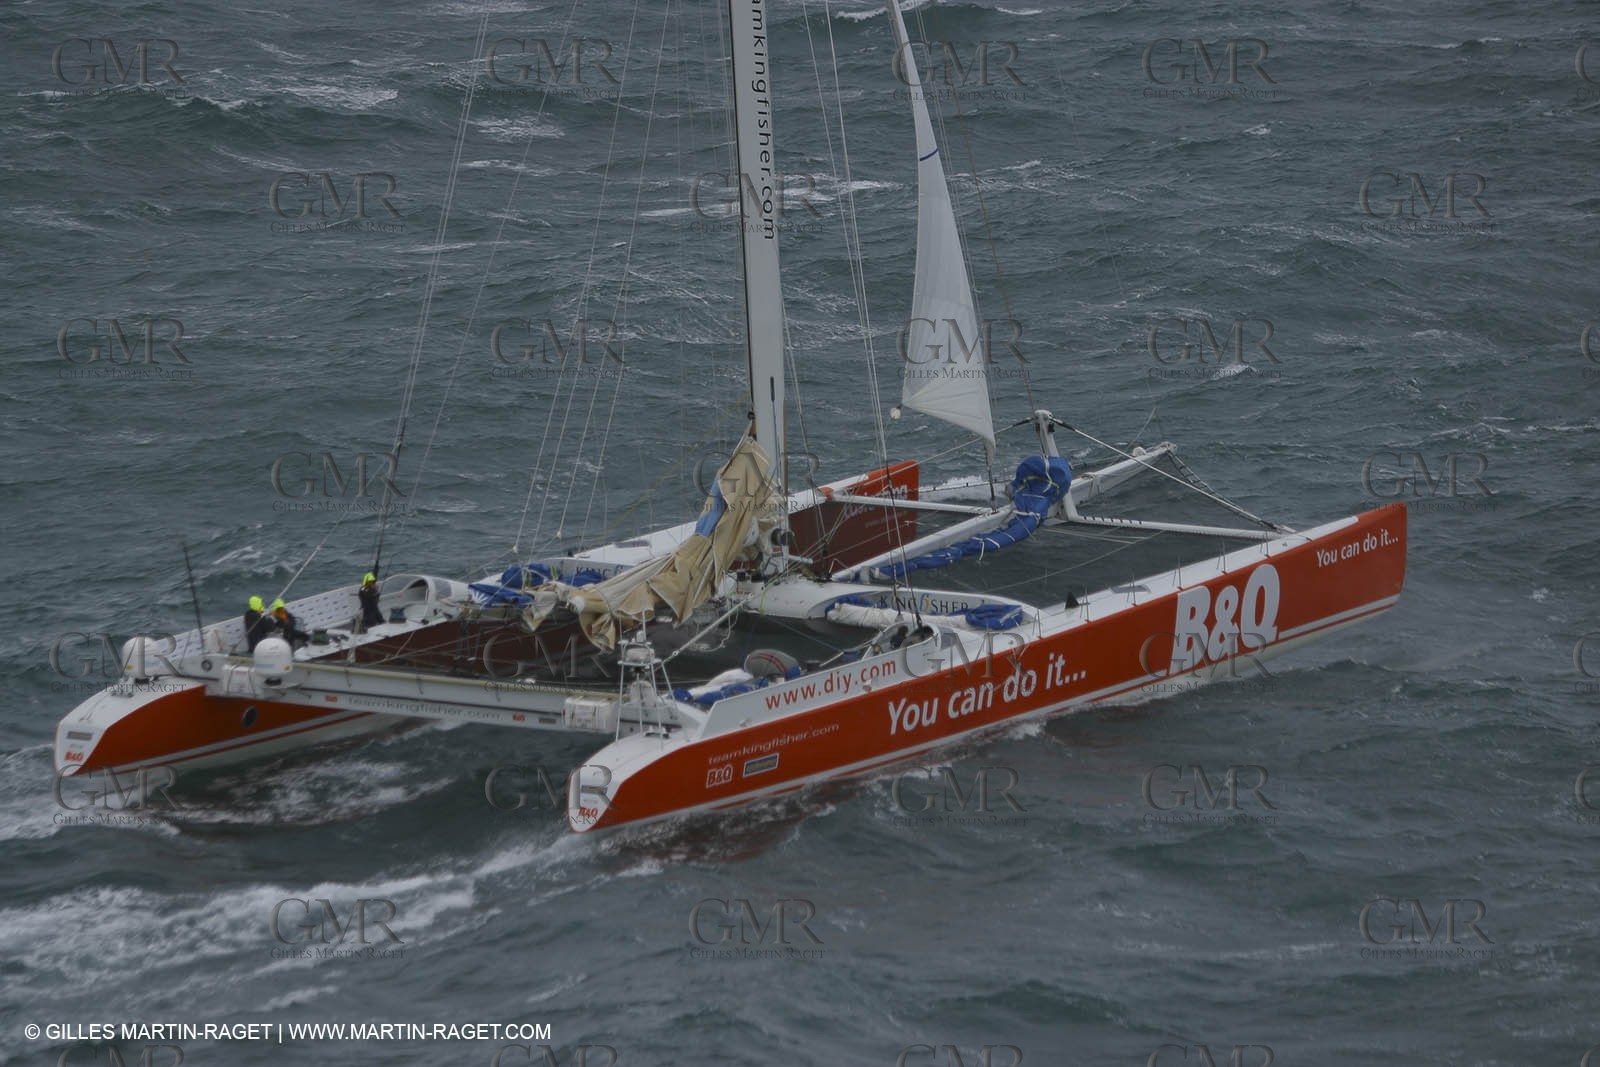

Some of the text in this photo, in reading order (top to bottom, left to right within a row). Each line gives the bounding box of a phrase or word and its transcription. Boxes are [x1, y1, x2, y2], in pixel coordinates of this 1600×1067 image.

[1316, 528, 1399, 568] You can do it...
[1170, 564, 1280, 674] B&Q
[765, 659, 897, 710] www.diy.com
[887, 652, 1087, 736] You can do it...
[708, 722, 840, 765] teamkingfisher.com
[706, 763, 734, 789] B&Q
